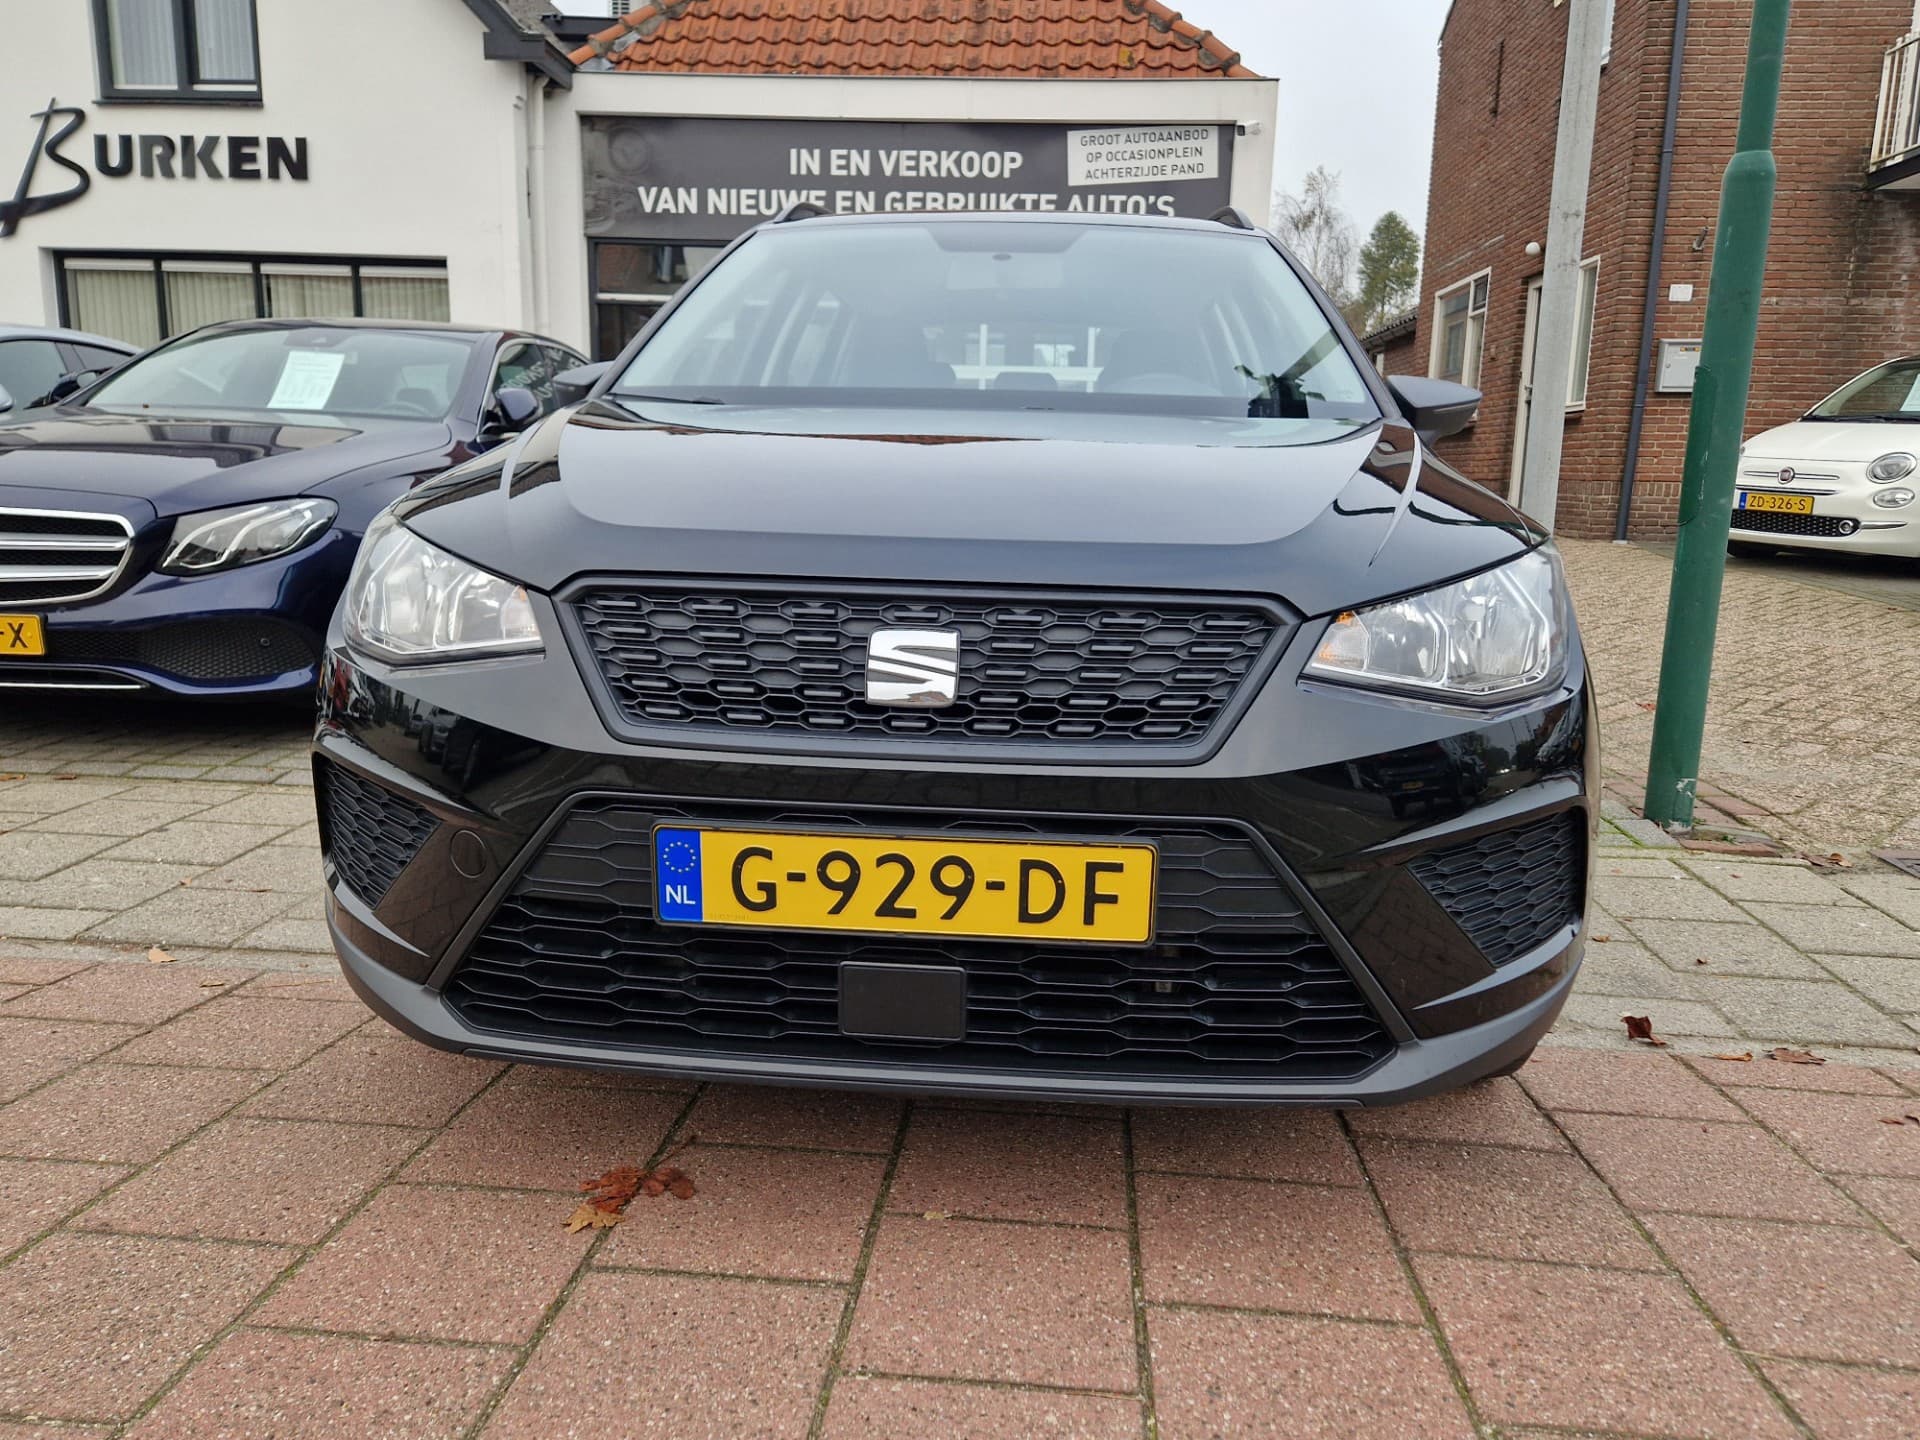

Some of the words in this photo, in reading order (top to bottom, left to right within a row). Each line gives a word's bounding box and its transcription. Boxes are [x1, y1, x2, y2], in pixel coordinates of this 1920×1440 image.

[1080, 133, 1121, 147] GROOT
[1124, 128, 1209, 145] AUTOAANBOD
[789, 148, 821, 176] IN
[830, 149, 870, 177] EN
[878, 149, 1023, 178] VERKOOP
[1086, 151, 1103, 164] OP
[1105, 146, 1203, 163] OCCASIONPLEIN
[0, 97, 309, 237] BURKEN
[1085, 164, 1168, 180] ACHTERZIJDE
[1170, 162, 1205, 176] PAND
[637, 186, 698, 214] VAN
[835, 190, 876, 214] EN
[1749, 495, 1807, 511] ZD-326-S
[665, 884, 696, 905] NL
[731, 846, 1125, 926] G-929-DF
